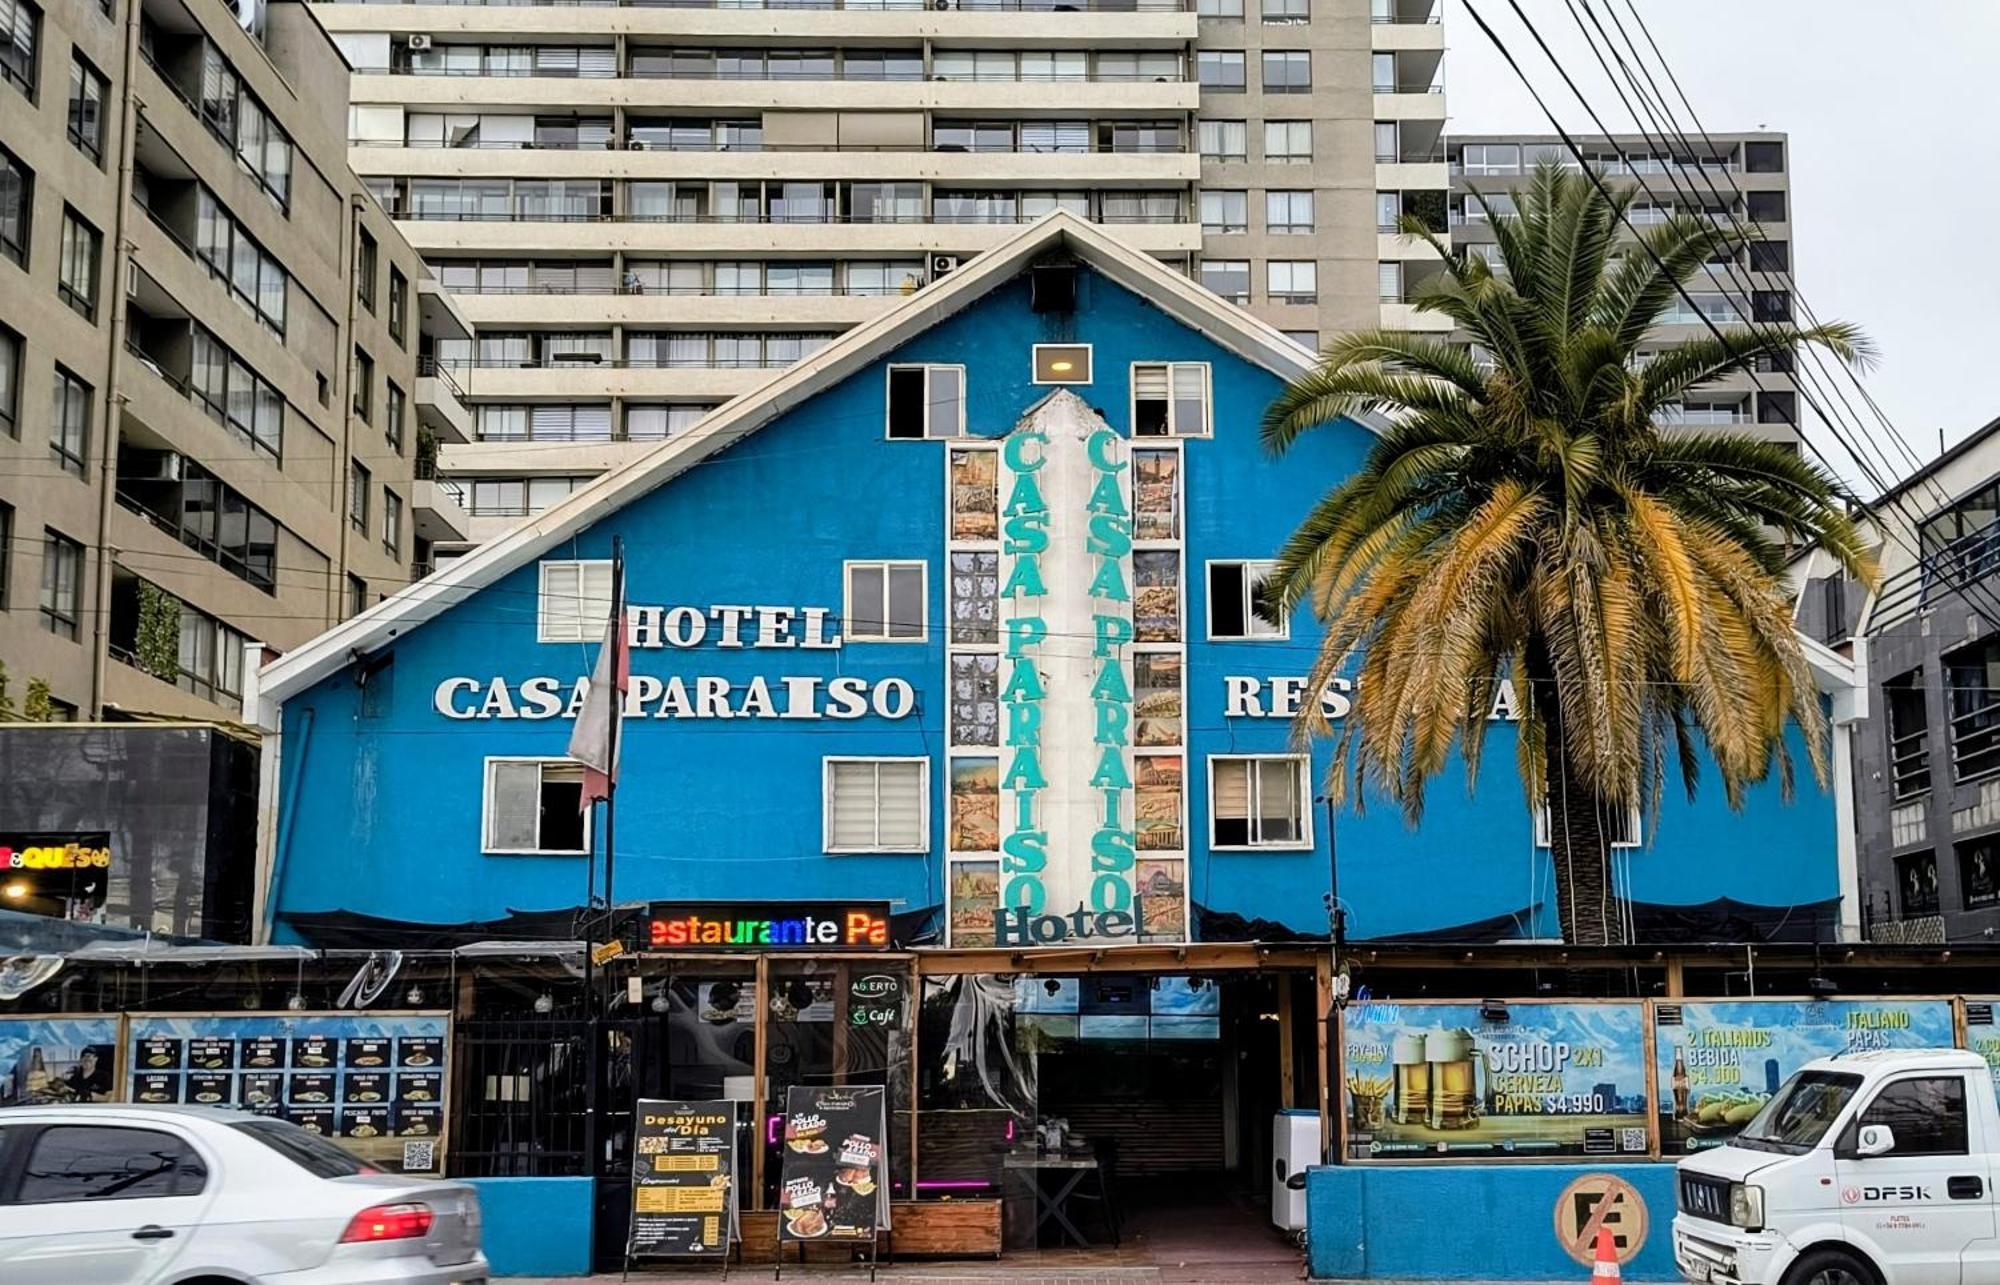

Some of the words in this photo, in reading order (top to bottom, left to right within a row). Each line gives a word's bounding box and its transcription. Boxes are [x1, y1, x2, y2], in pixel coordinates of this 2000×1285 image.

[1002, 432, 1050, 599] CASA
[1086, 430, 1132, 602] CASA
[626, 604, 842, 649] HOTEL
[434, 676, 593, 720] CASA
[621, 675, 915, 720] PARAISO
[1002, 617, 1049, 917] PARAISO
[1090, 614, 1136, 914] PARAISO
[992, 893, 1147, 947] Hotel
[869, 1008, 896, 1026] Café
[1847, 1012, 1909, 1029] ITALIANO
[1688, 1031, 1698, 1047] 2
[1702, 1029, 1772, 1047] ITALIANOS
[1847, 1031, 1890, 1047] PAPAS
[1489, 1042, 1570, 1073] SCHOP
[1689, 1048, 1740, 1067] BEBIDA
[1493, 1074, 1564, 1093] CERVEZA
[1494, 1094, 1542, 1114] PAPAS
[1547, 1093, 1604, 1114] $4.990
[644, 1115, 726, 1126] Desayuno
[1863, 1186, 1932, 1200] DFSK
[1574, 1193, 1627, 1249] E
